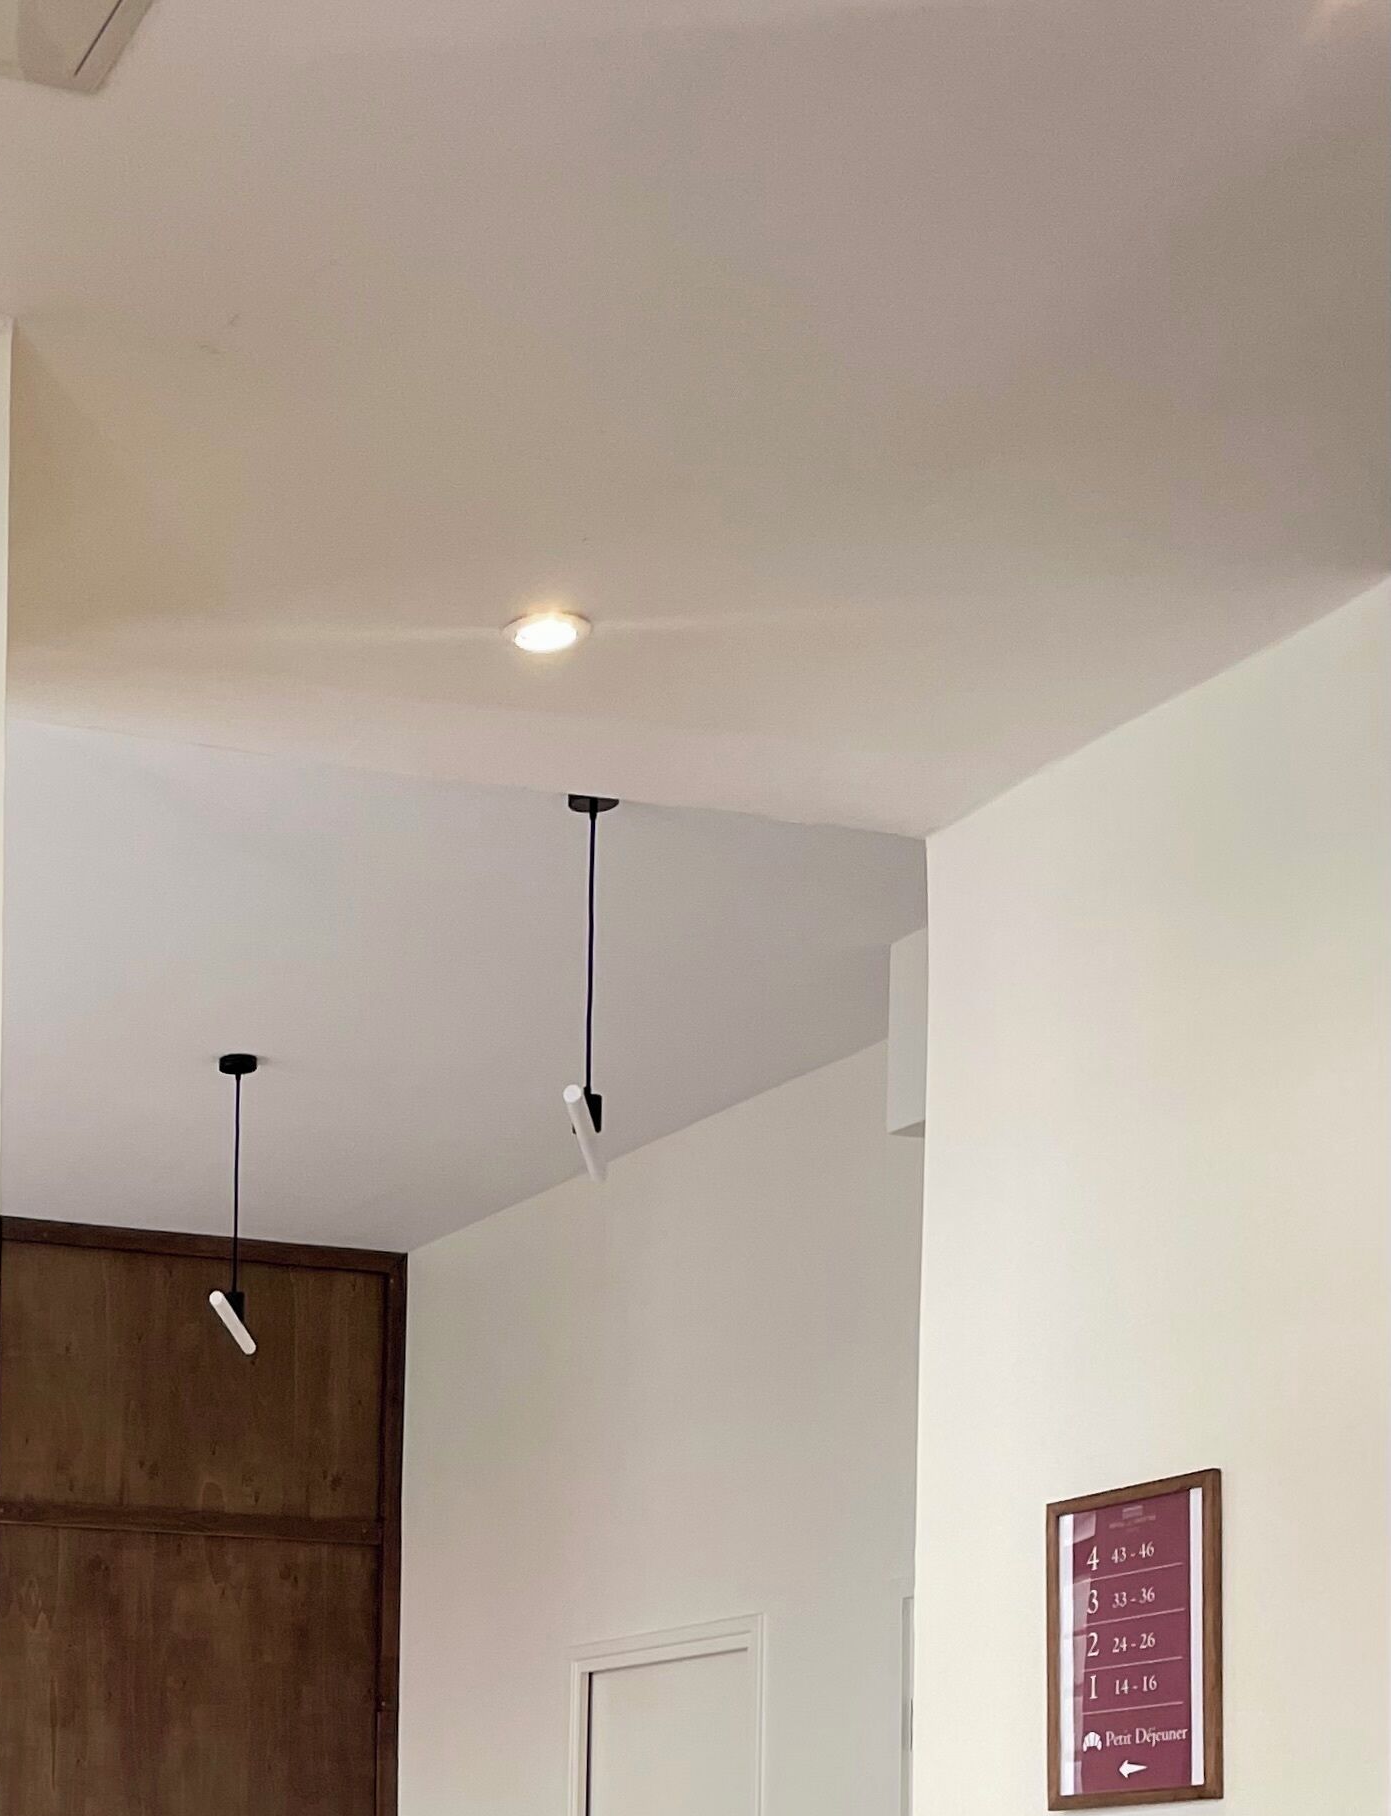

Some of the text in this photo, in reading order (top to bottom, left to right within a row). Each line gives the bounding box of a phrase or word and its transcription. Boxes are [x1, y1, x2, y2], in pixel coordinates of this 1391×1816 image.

[1086, 1545, 1100, 1571] 4
[1111, 1547, 1127, 1564] 43
[1138, 1541, 1155, 1558] 46
[1086, 1589, 1099, 1614] 3
[1112, 1591, 1127, 1608] 33
[1138, 1586, 1156, 1604] 36
[1087, 1632, 1100, 1657] 2
[1112, 1636, 1127, 1653] 24
[1139, 1632, 1156, 1649] 26
[1089, 1674, 1099, 1700] 1
[1115, 1678, 1130, 1695] 14
[1142, 1674, 1158, 1692] 16
[1105, 1727, 1189, 1748] Petit Déjeuner
